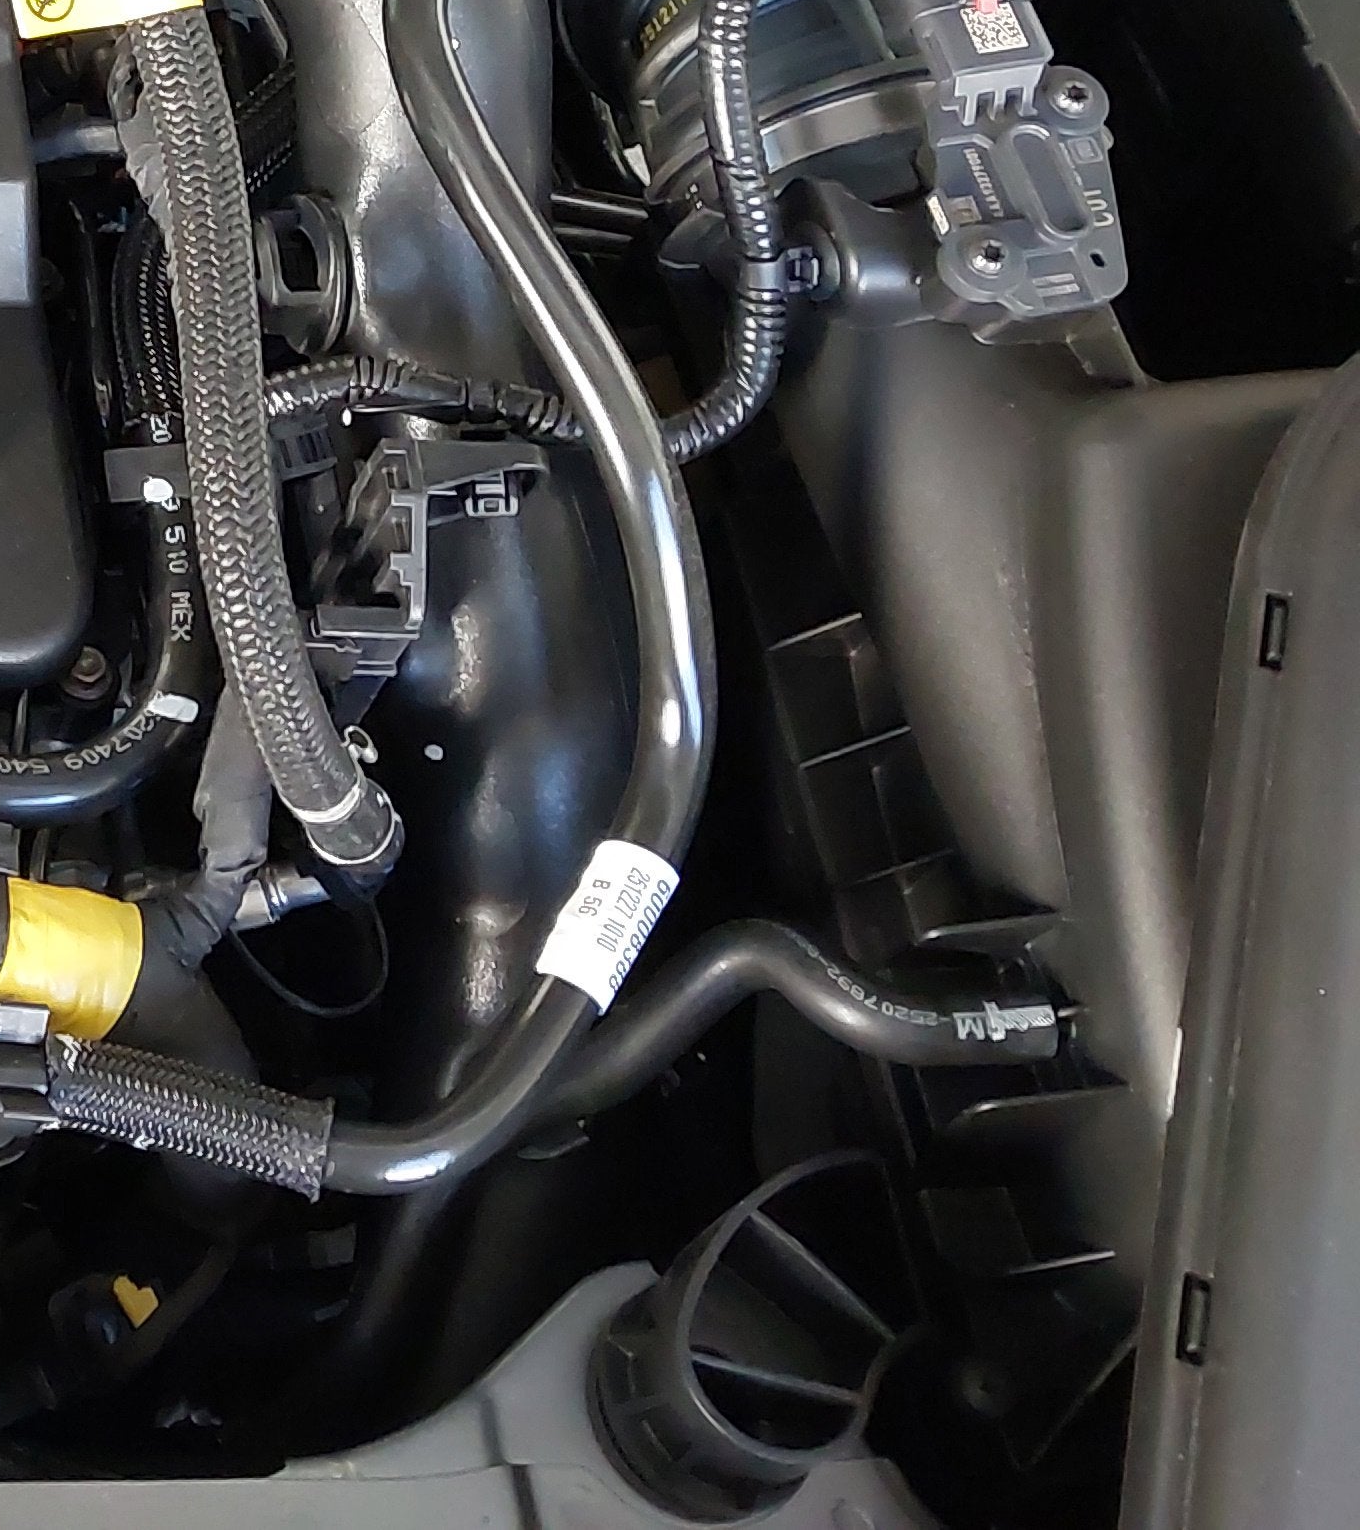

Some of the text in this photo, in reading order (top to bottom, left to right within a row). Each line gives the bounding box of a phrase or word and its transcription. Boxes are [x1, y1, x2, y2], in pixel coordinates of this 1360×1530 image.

[168, 591, 195, 642] MEX
[63, 708, 161, 771] 207409
[578, 895, 603, 917] 56
